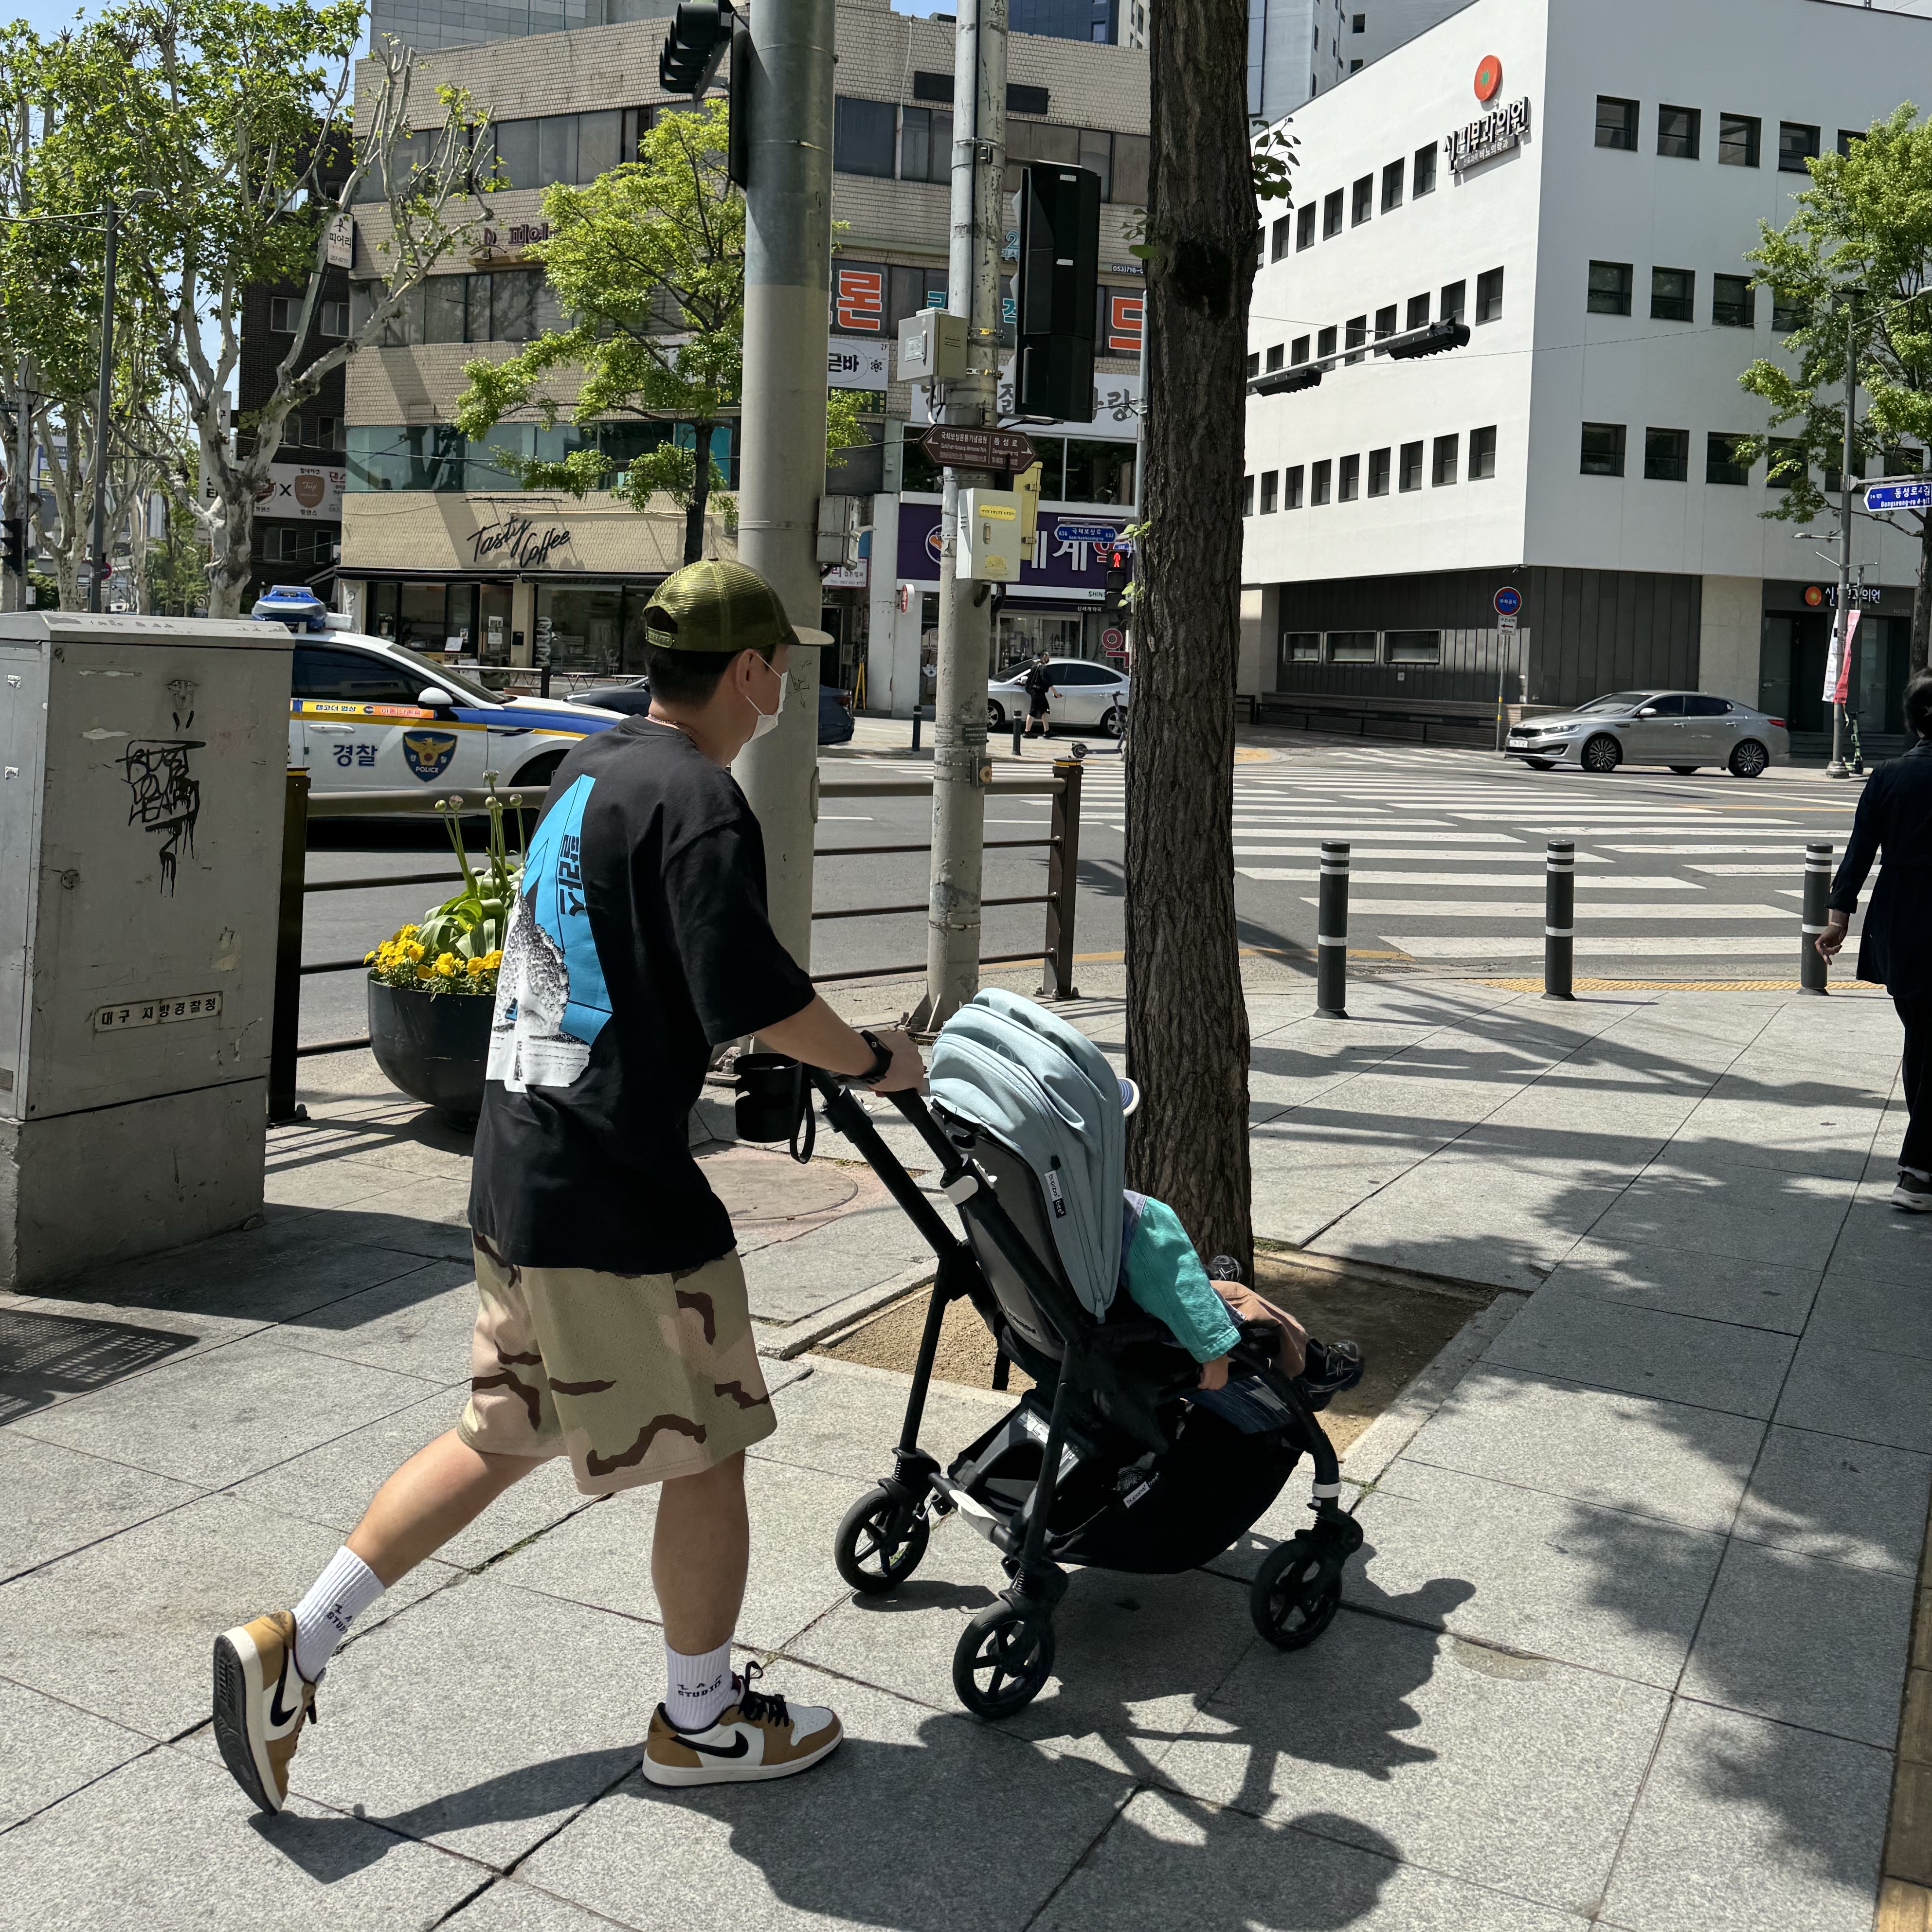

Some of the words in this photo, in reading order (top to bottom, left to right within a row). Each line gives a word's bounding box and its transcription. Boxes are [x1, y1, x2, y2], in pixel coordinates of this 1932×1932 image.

[1443, 97, 1529, 175] 신피부과의원
[1479, 138, 1508, 159] 비뇨의학과
[329, 233, 351, 249] 피어리
[509, 222, 560, 245] 피어
[830, 269, 882, 331] 론
[828, 353, 860, 373] 귿바
[1880, 499, 1916, 507] Dongseong-ro
[1895, 486, 1930, 499] 동성로4길
[467, 512, 533, 562] Tasty
[520, 528, 571, 568] Coffee
[333, 744, 378, 767] 경찰
[142, 997, 216, 1019] 지방경찰청
